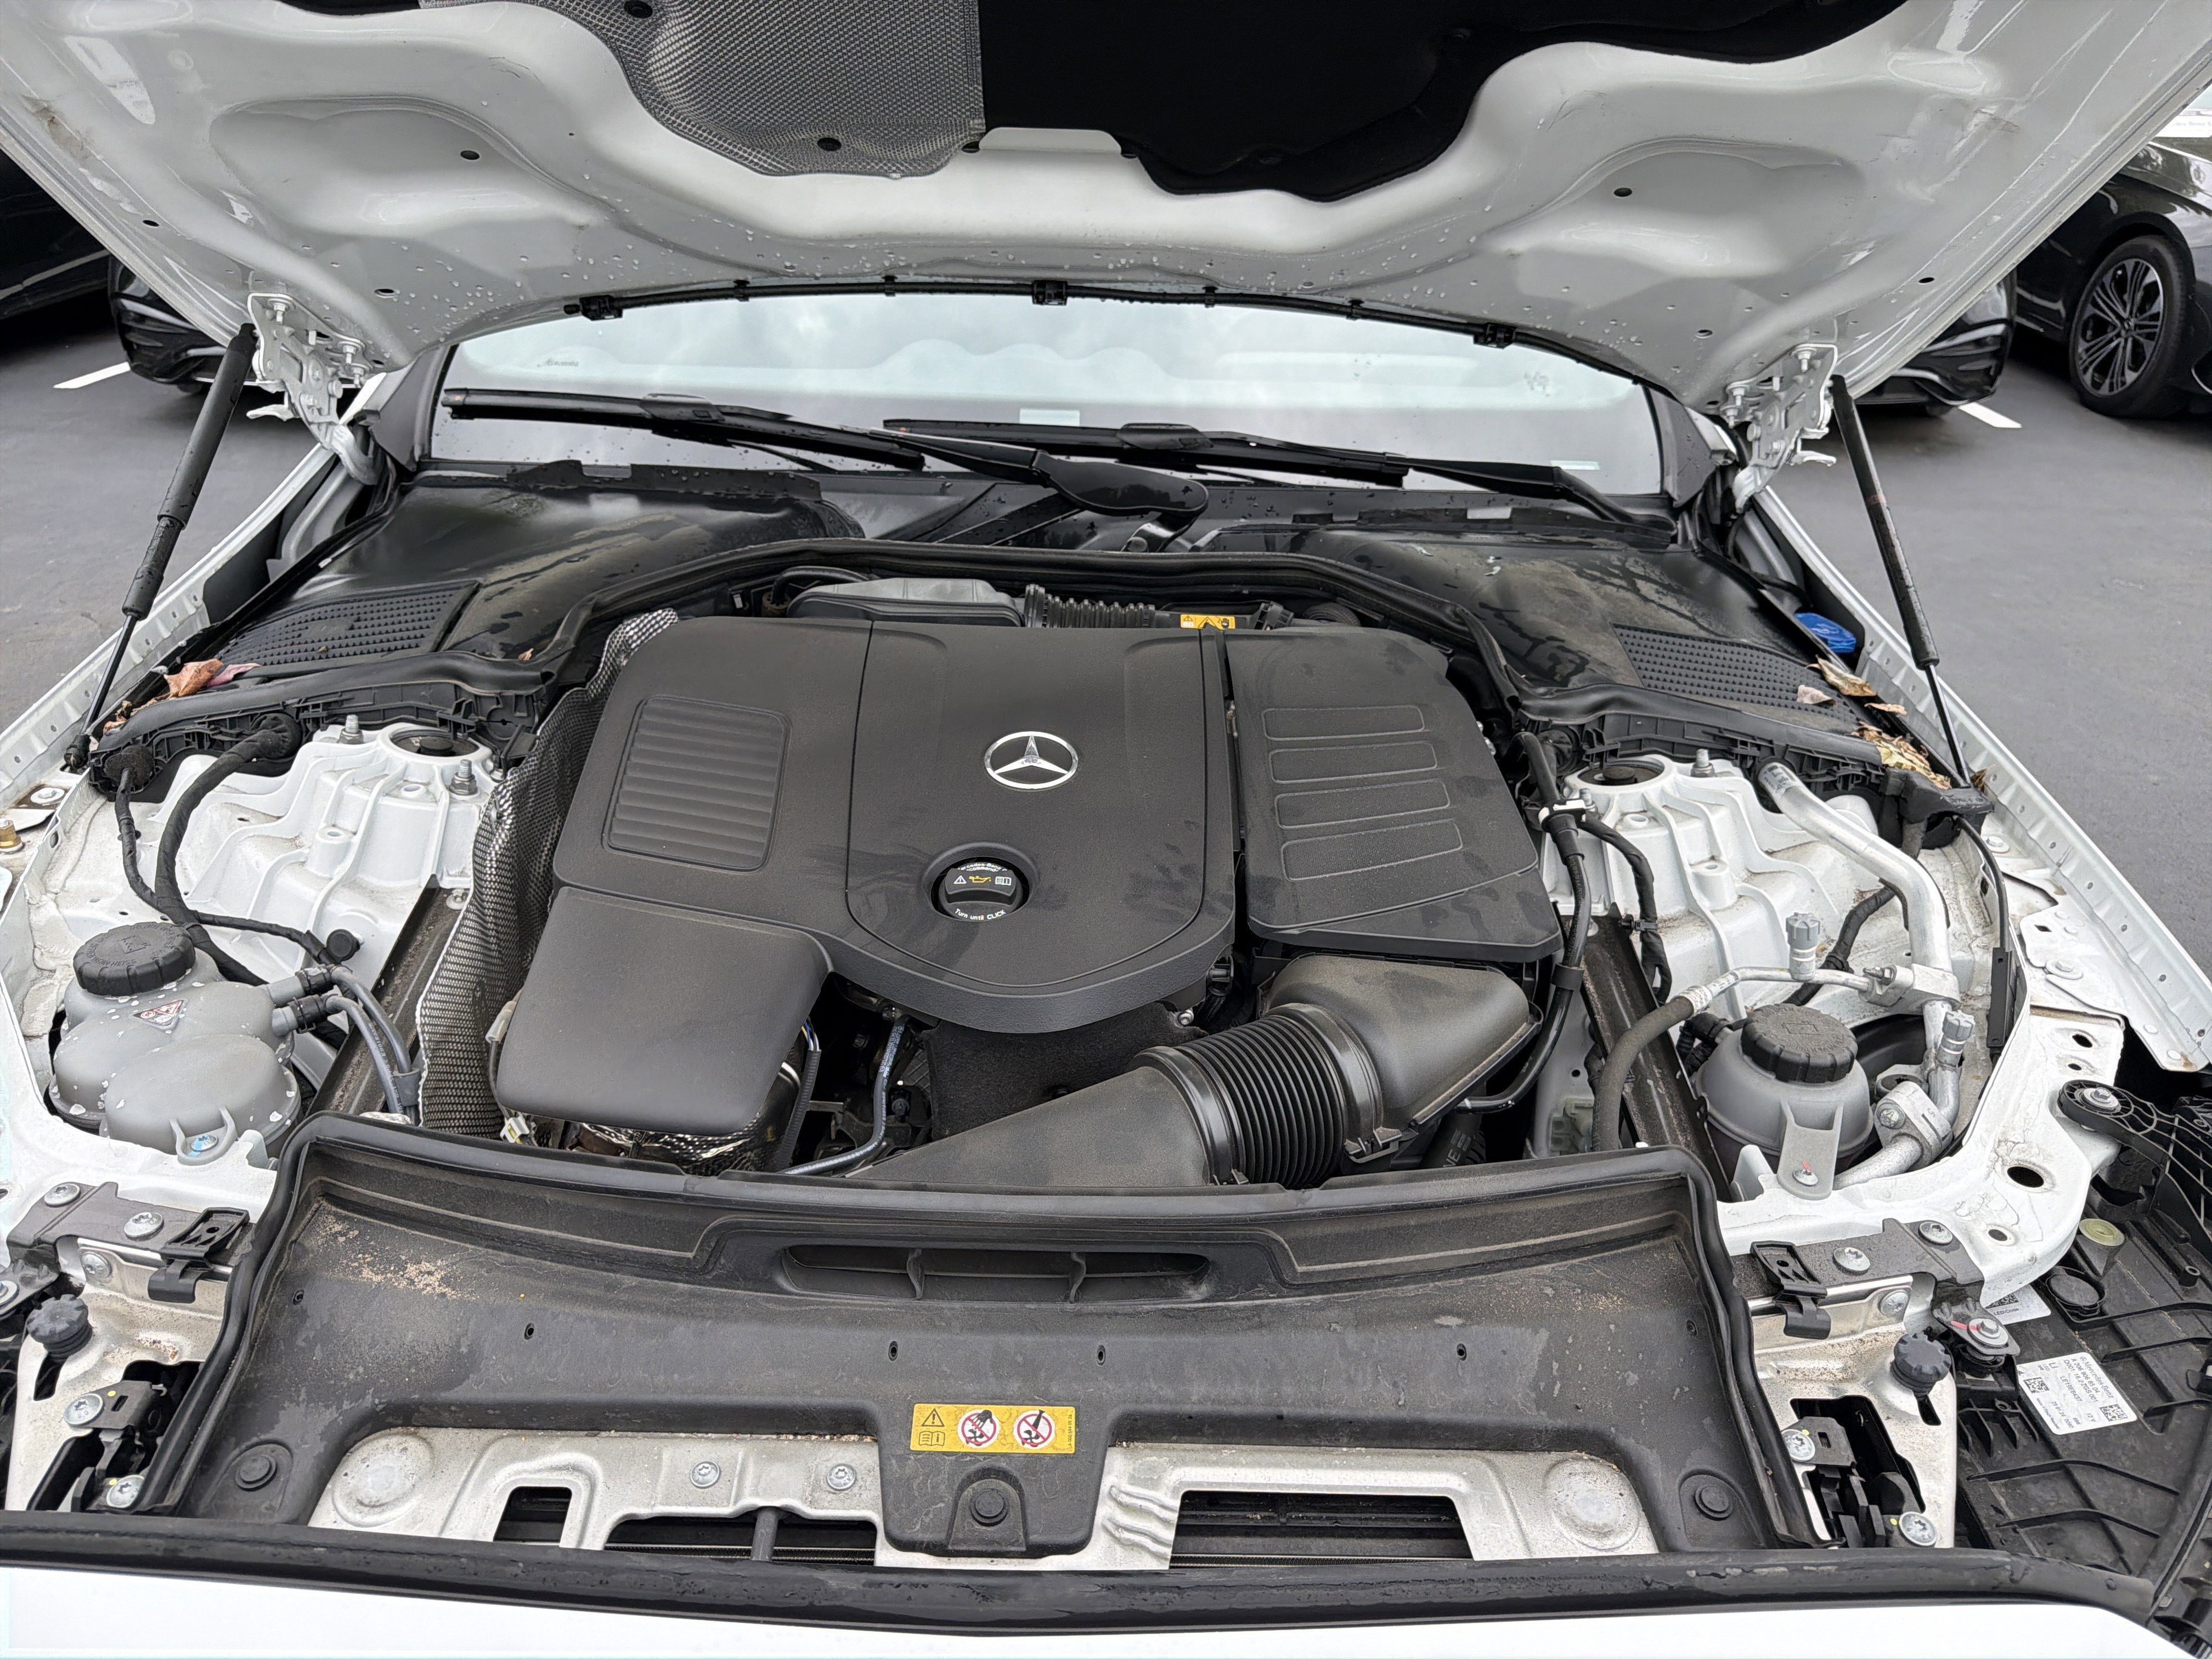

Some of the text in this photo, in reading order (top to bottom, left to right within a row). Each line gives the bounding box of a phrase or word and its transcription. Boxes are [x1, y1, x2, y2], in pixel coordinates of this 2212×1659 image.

[955, 908, 968, 918] Turn
[986, 910, 1006, 920] CLICK
[1993, 1308, 2019, 1316] LED-Code
[2074, 1363, 2084, 1371] 206
[2081, 1372, 2090, 1380] 906
[2082, 1362, 2114, 1398] Mercedes-Benz
[2089, 1393, 2098, 1402] 001
